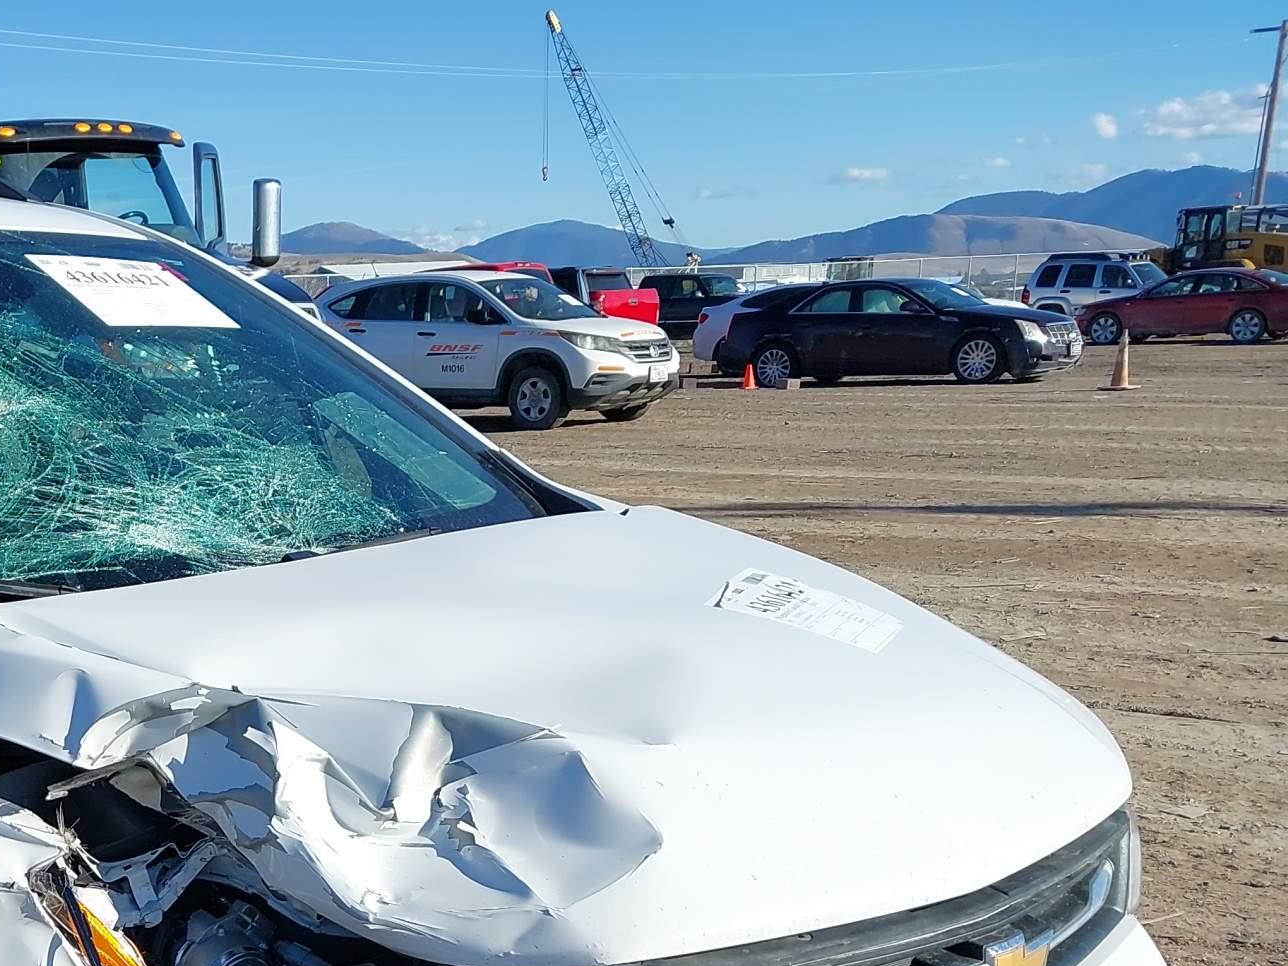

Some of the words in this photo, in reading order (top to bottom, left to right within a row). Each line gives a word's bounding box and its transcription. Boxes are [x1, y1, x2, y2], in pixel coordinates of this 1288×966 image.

[66, 270, 171, 287] 43616421
[429, 344, 484, 352] BNSF
[441, 364, 465, 373] M1016
[745, 577, 805, 613] 43616421
